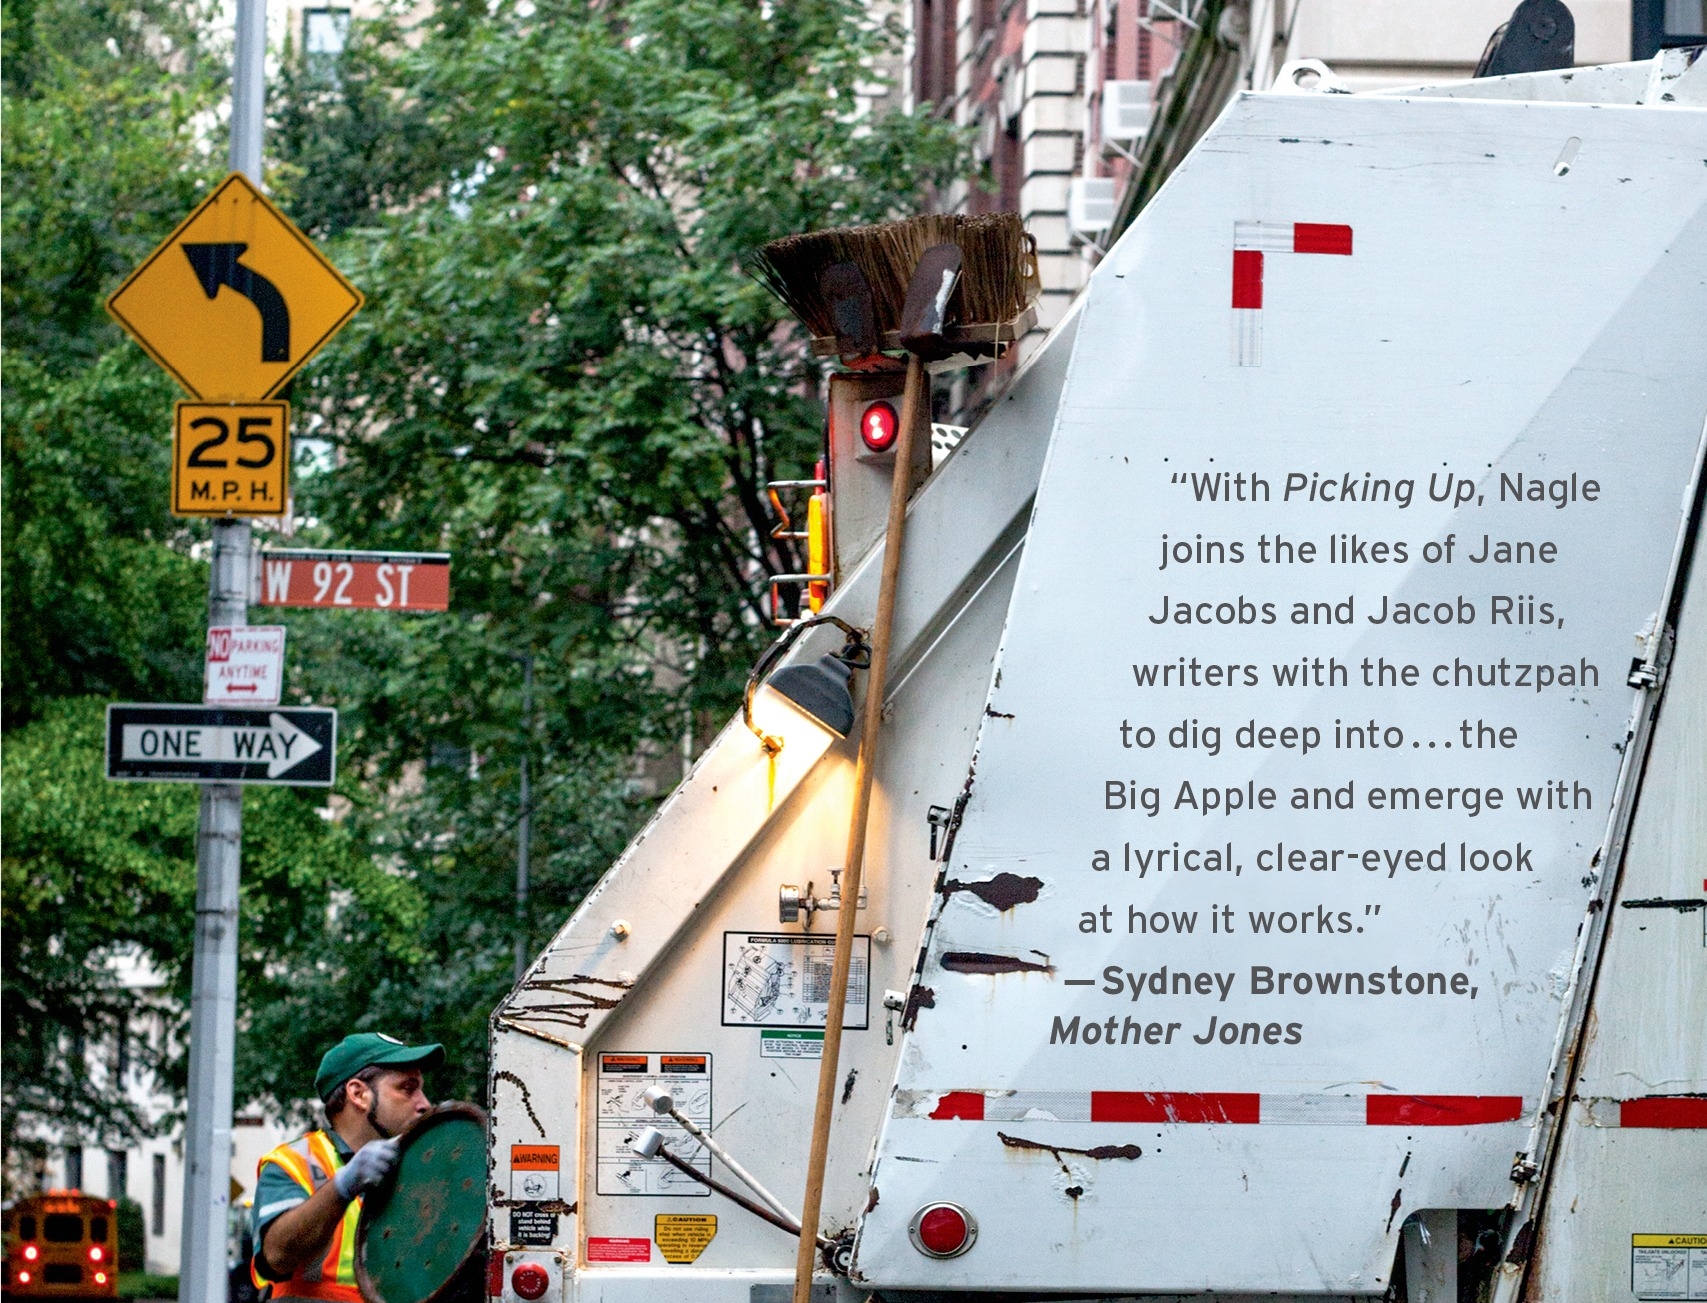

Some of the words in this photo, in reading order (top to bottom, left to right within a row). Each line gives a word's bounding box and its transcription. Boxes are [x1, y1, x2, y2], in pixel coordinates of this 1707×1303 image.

[188, 417, 275, 468] 25
[266, 561, 292, 603] W
[313, 562, 354, 605] 92
[375, 564, 413, 607] ST
[210, 633, 230, 658] NO
[231, 640, 278, 653] PARKING
[219, 664, 268, 679] ANYTIME
[141, 730, 202, 756] ONE
[234, 731, 298, 759] WAY
[520, 1153, 558, 1164] WARNING
